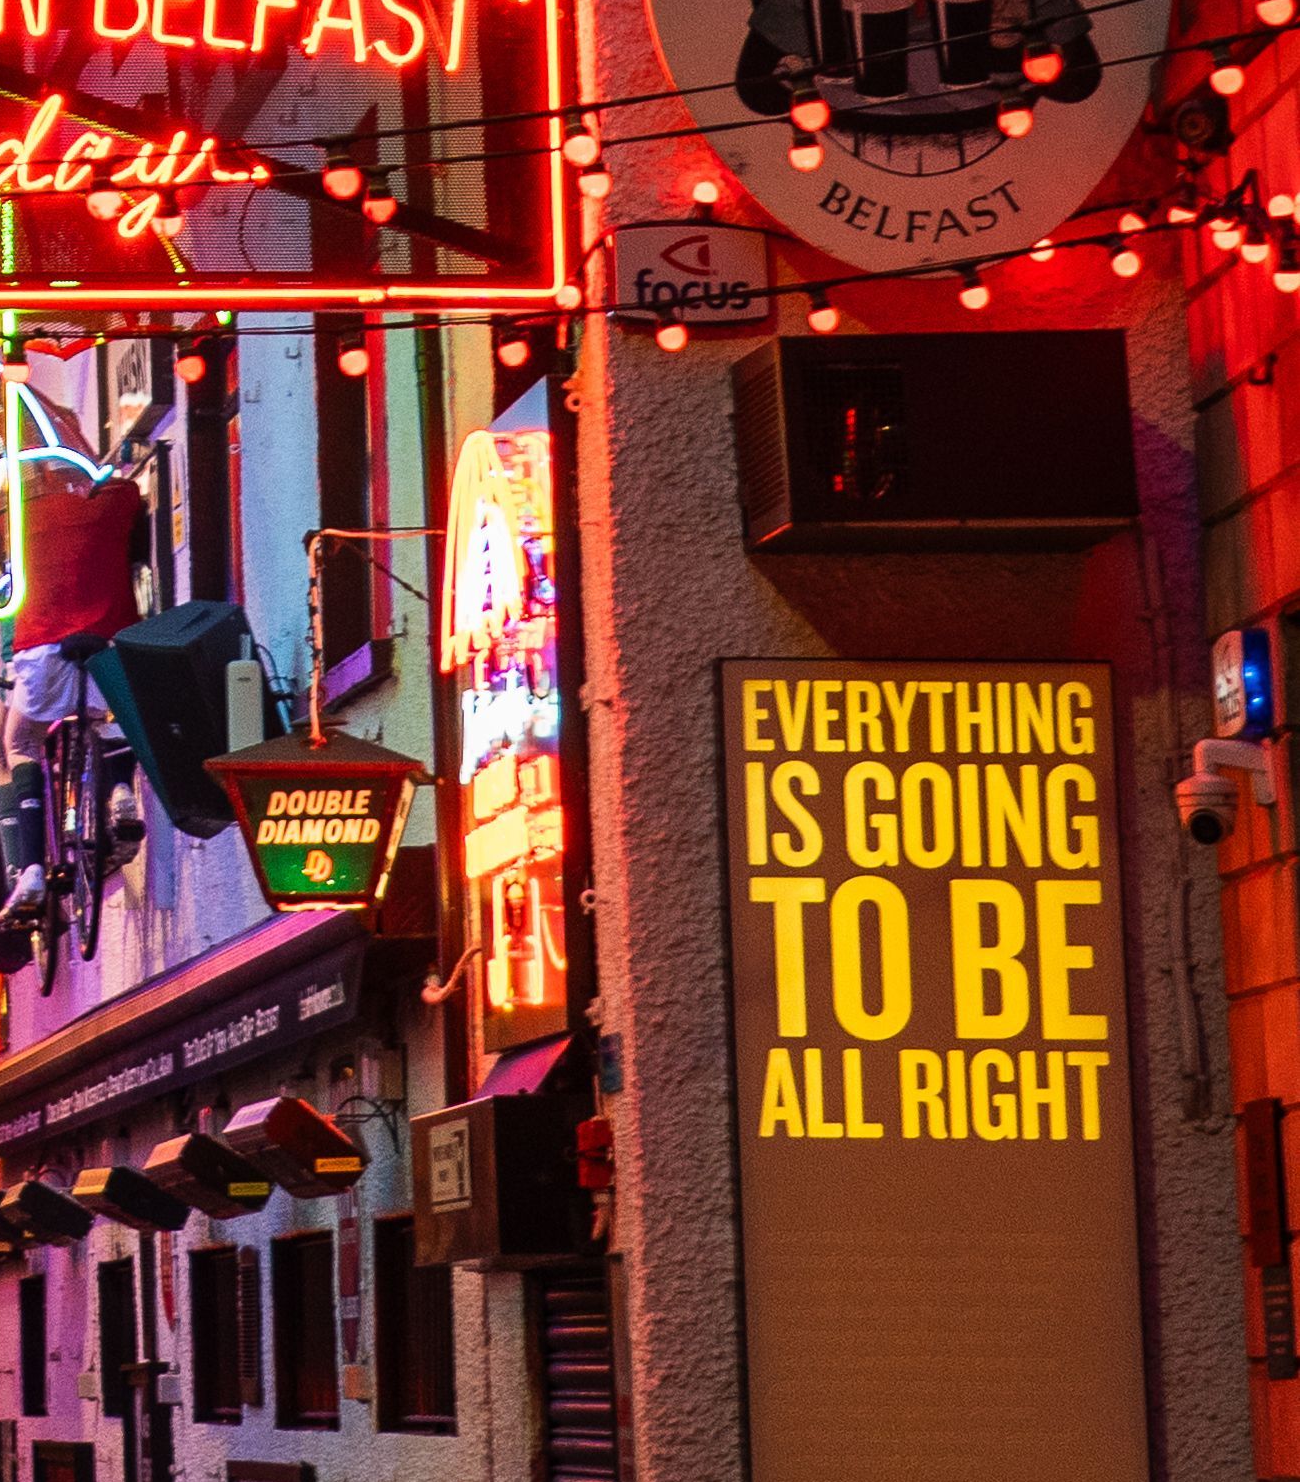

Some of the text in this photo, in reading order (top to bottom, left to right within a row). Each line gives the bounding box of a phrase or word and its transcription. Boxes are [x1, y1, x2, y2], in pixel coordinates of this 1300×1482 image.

[816, 178, 1023, 245] BELFAST
[634, 268, 750, 311] focus
[741, 678, 1096, 755] EVERYTHING
[257, 818, 380, 845] DIAMOND
[266, 790, 372, 818] DOUBLE
[744, 760, 1101, 870] IS GOING
[748, 875, 1109, 1042] TO BE
[758, 1047, 1110, 1141] ALL RIGHT
